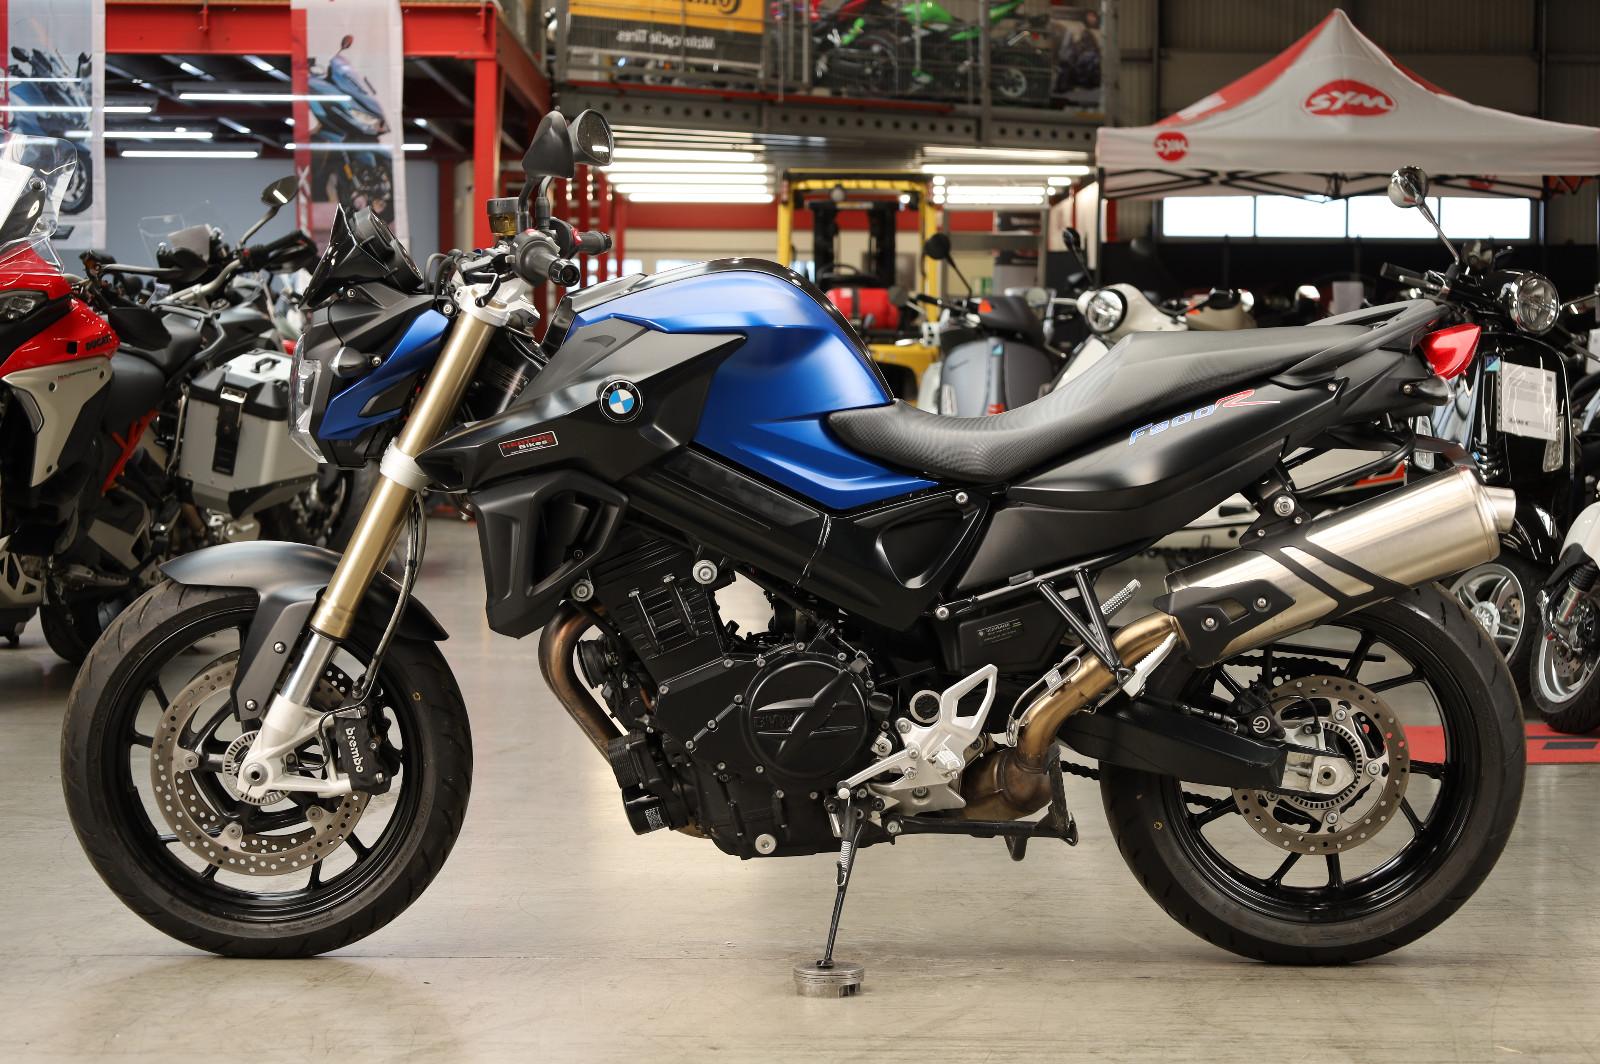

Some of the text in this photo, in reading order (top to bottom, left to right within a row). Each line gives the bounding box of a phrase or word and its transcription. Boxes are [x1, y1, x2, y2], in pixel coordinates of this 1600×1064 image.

[1308, 90, 1395, 111] SYM
[1155, 138, 1188, 156] SYM
[518, 439, 548, 450] Bikes
[345, 726, 364, 773] brembo
